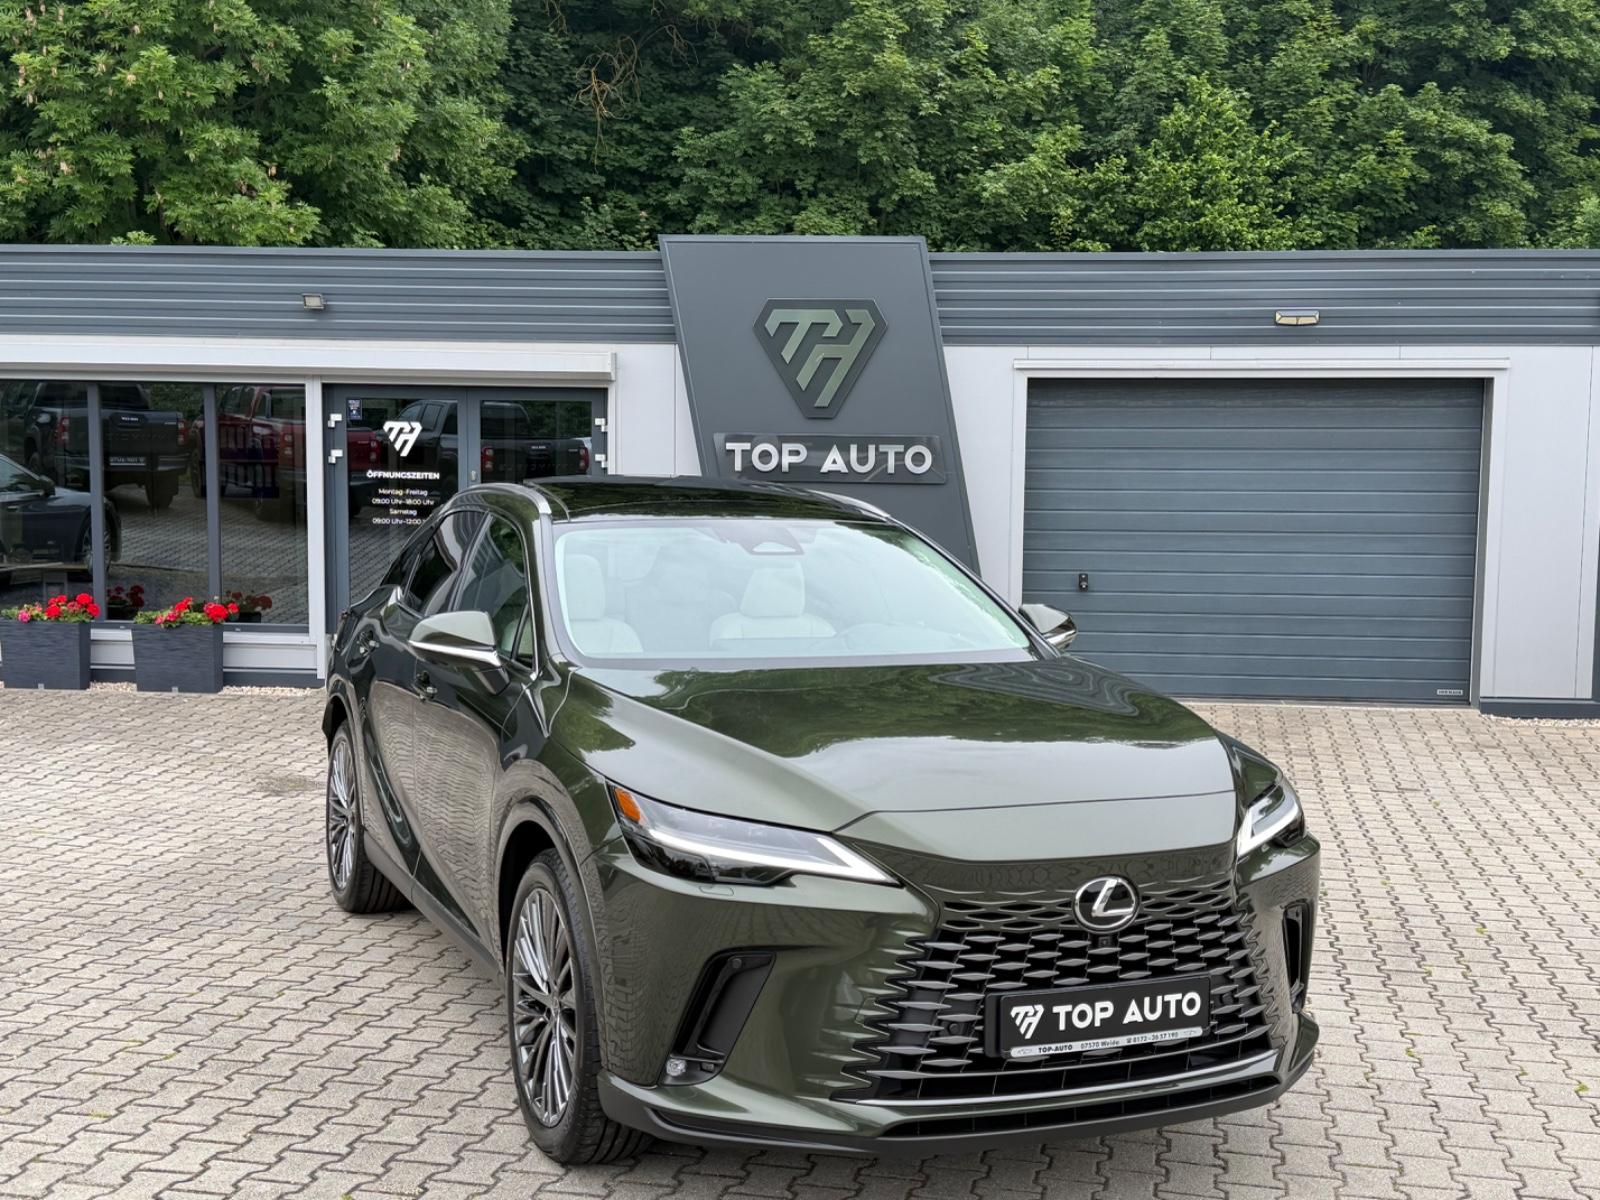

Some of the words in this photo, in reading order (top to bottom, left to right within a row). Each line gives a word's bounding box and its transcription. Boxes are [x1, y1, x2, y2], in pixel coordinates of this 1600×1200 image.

[726, 442, 807, 472] TOP
[820, 444, 932, 474] AUTO
[366, 470, 440, 479] ÖFFNUNGSZEITEN
[389, 508, 418, 516] Samstag
[1052, 1001, 1114, 1031] TOP
[1122, 991, 1201, 1024] AUTO
[1038, 1044, 1073, 1053] TOP-AUTO
